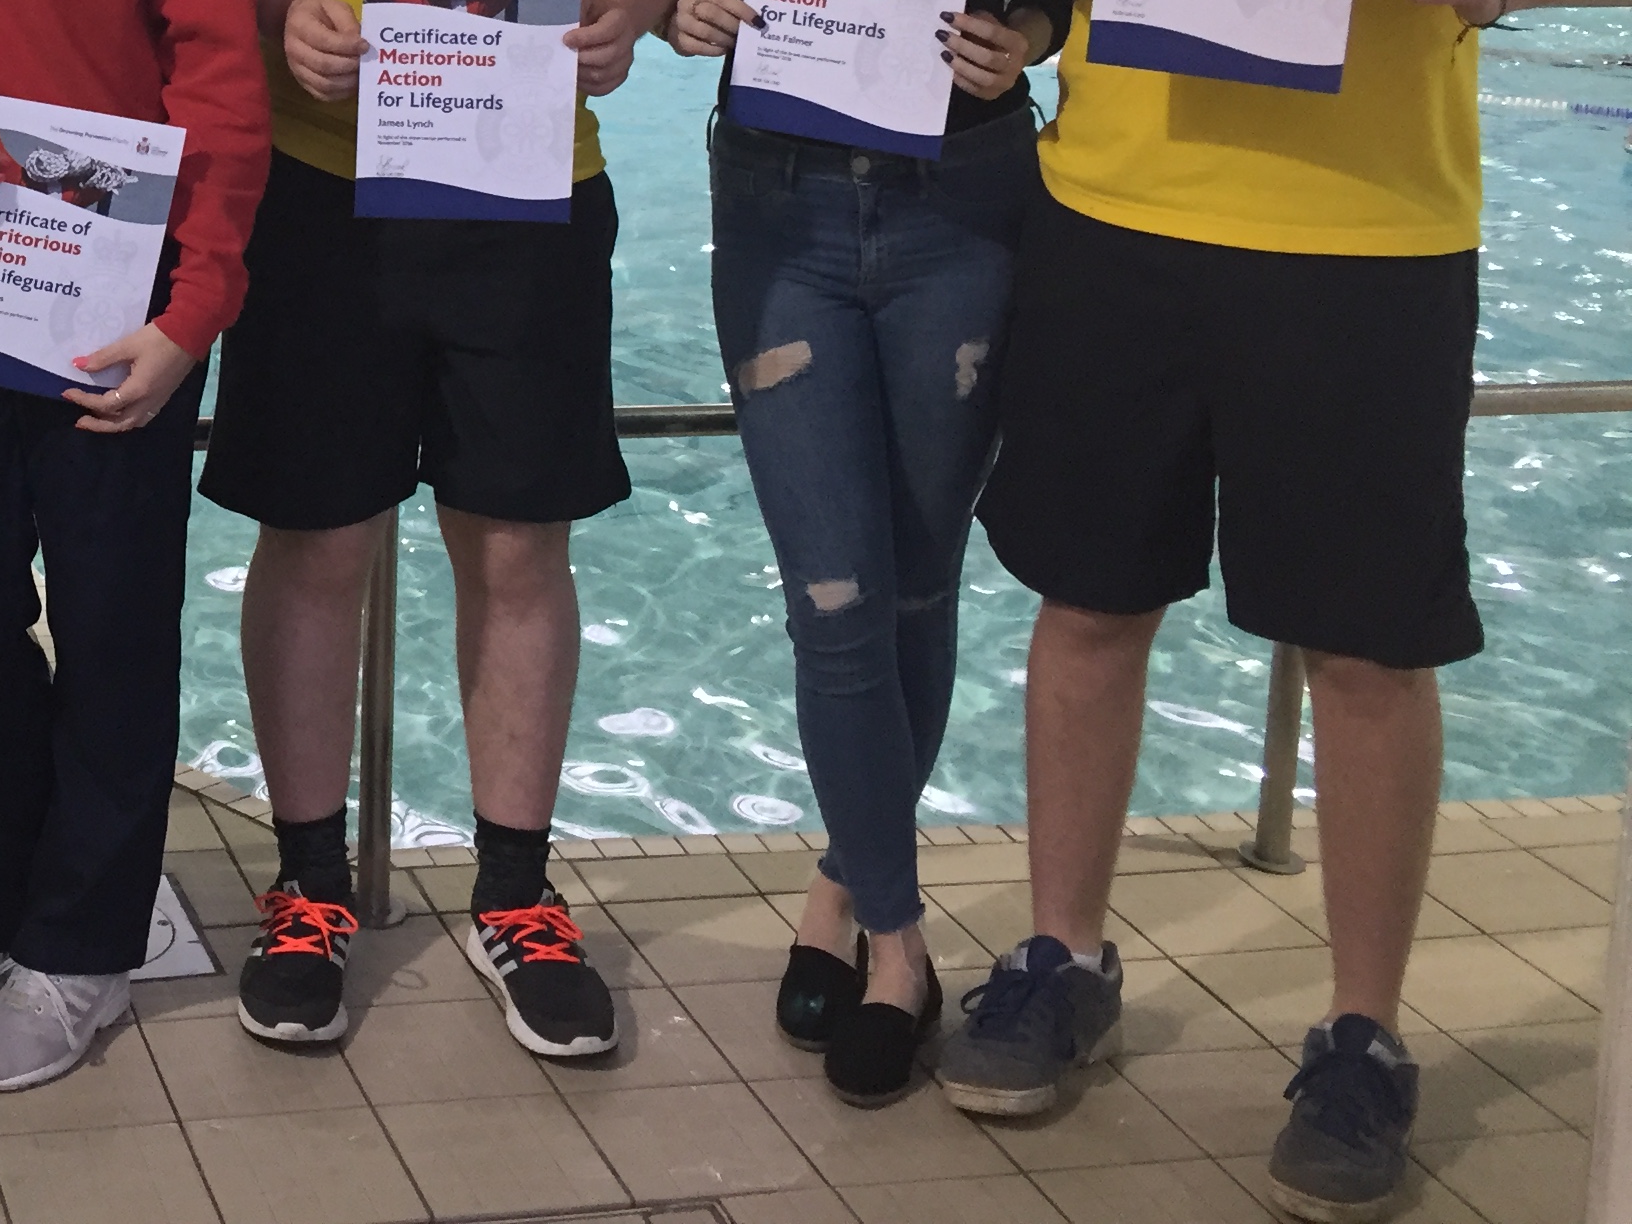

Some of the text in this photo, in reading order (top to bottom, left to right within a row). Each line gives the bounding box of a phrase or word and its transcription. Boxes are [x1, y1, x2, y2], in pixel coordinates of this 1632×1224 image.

[760, 5, 886, 40] for Lifeguards
[380, 27, 502, 46] Certificate of
[379, 48, 496, 67] Meritorious
[378, 70, 442, 87] Action
[378, 92, 504, 113] for Lifeguards
[378, 119, 434, 129] James Lynch
[72, 221, 92, 236] of
